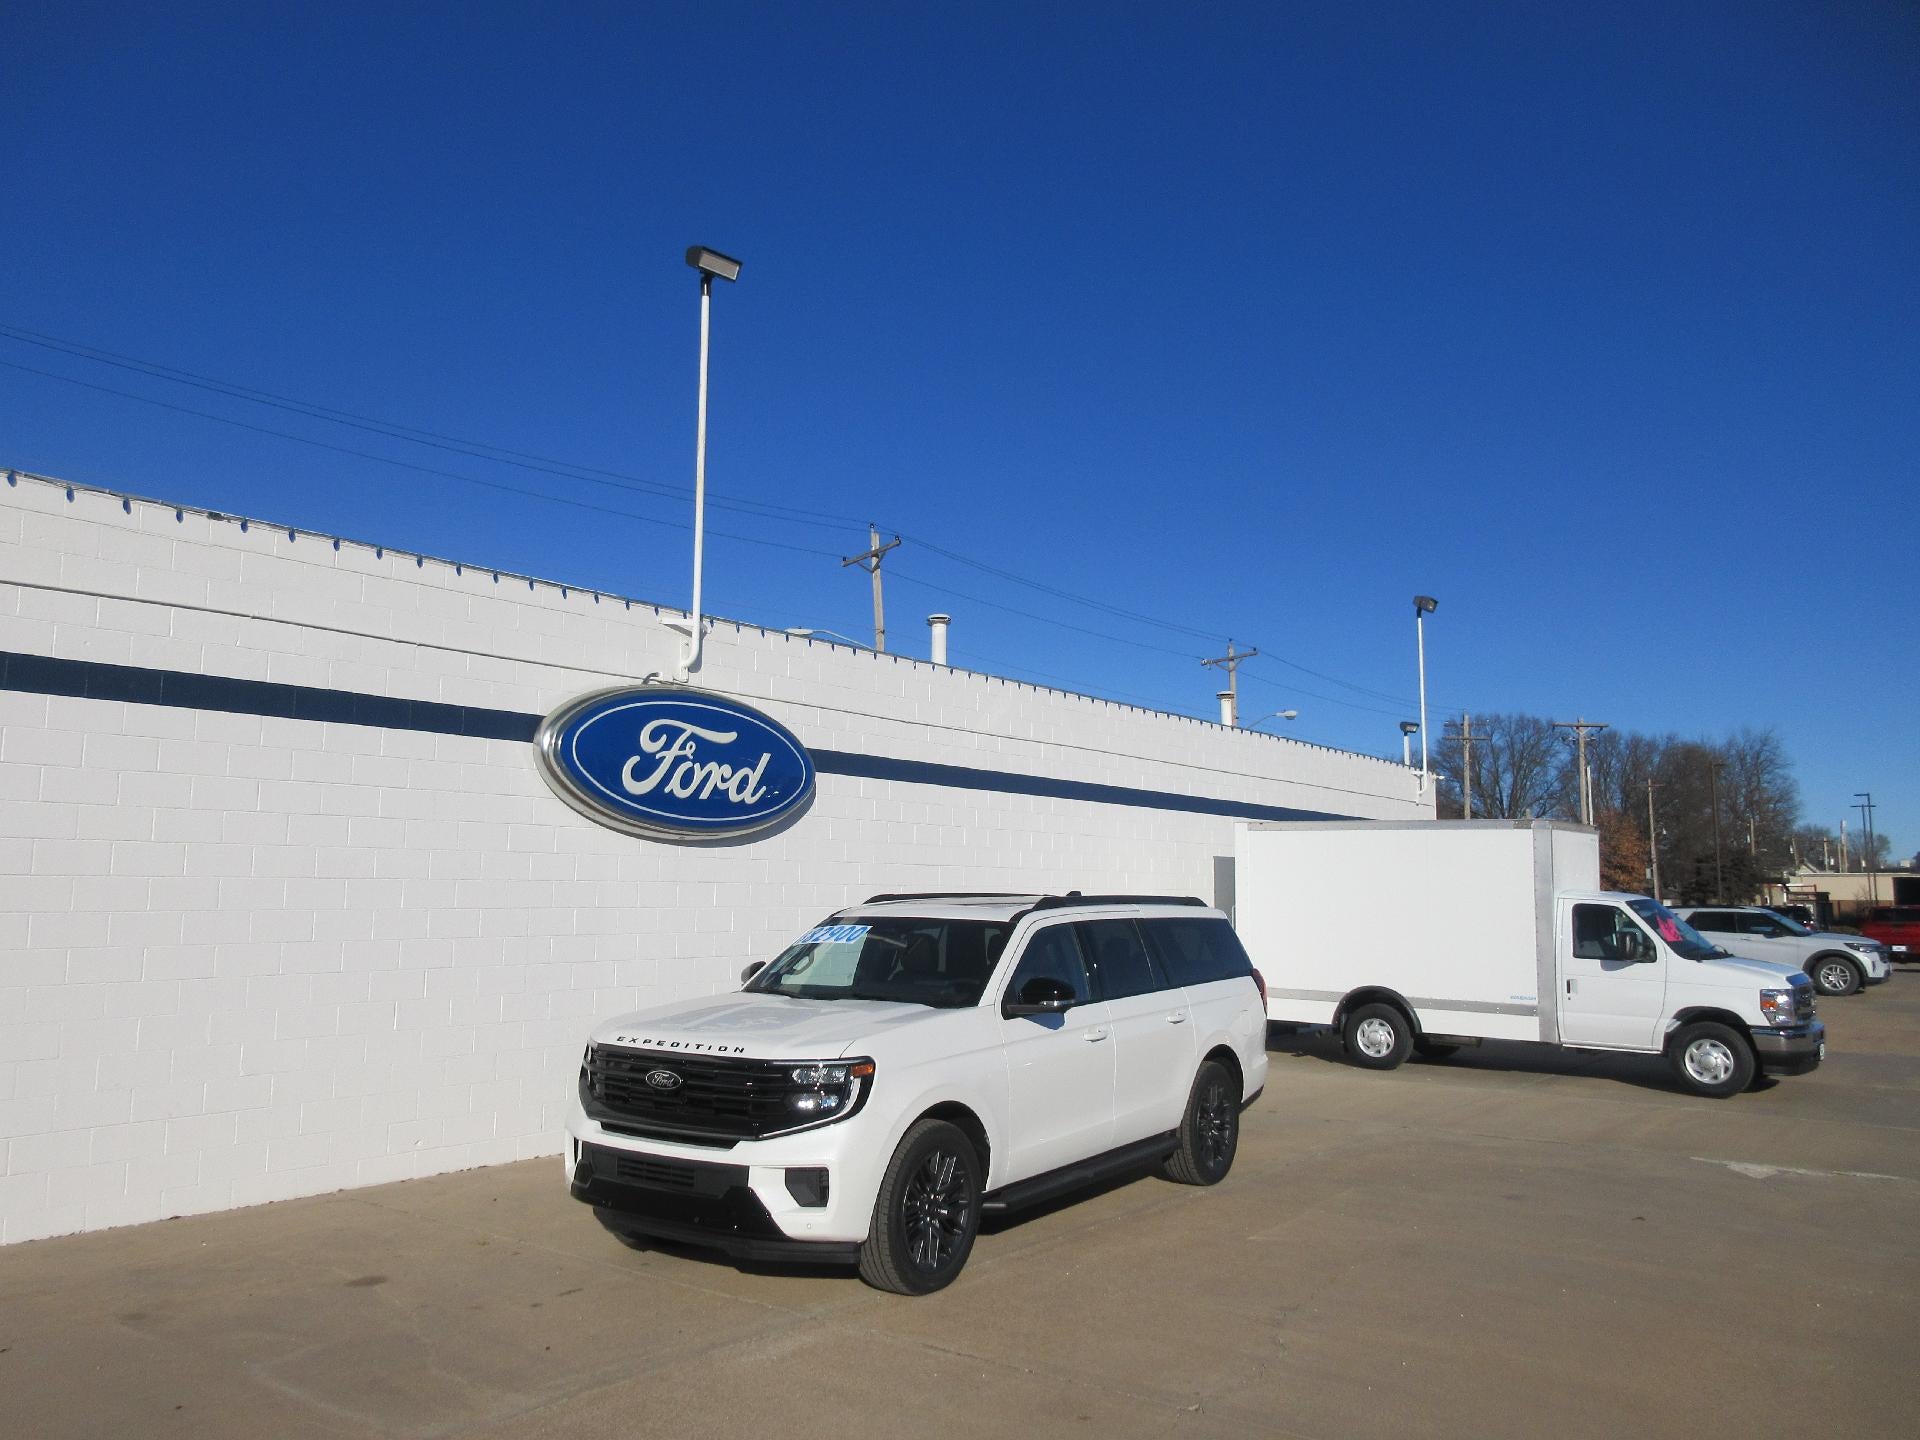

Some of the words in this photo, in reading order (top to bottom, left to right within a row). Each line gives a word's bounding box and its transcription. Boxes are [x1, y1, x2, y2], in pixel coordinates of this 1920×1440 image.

[622, 719, 771, 804] Ford
[616, 1036, 745, 1053] EXPEDITION
[652, 1072, 675, 1087] Ford
